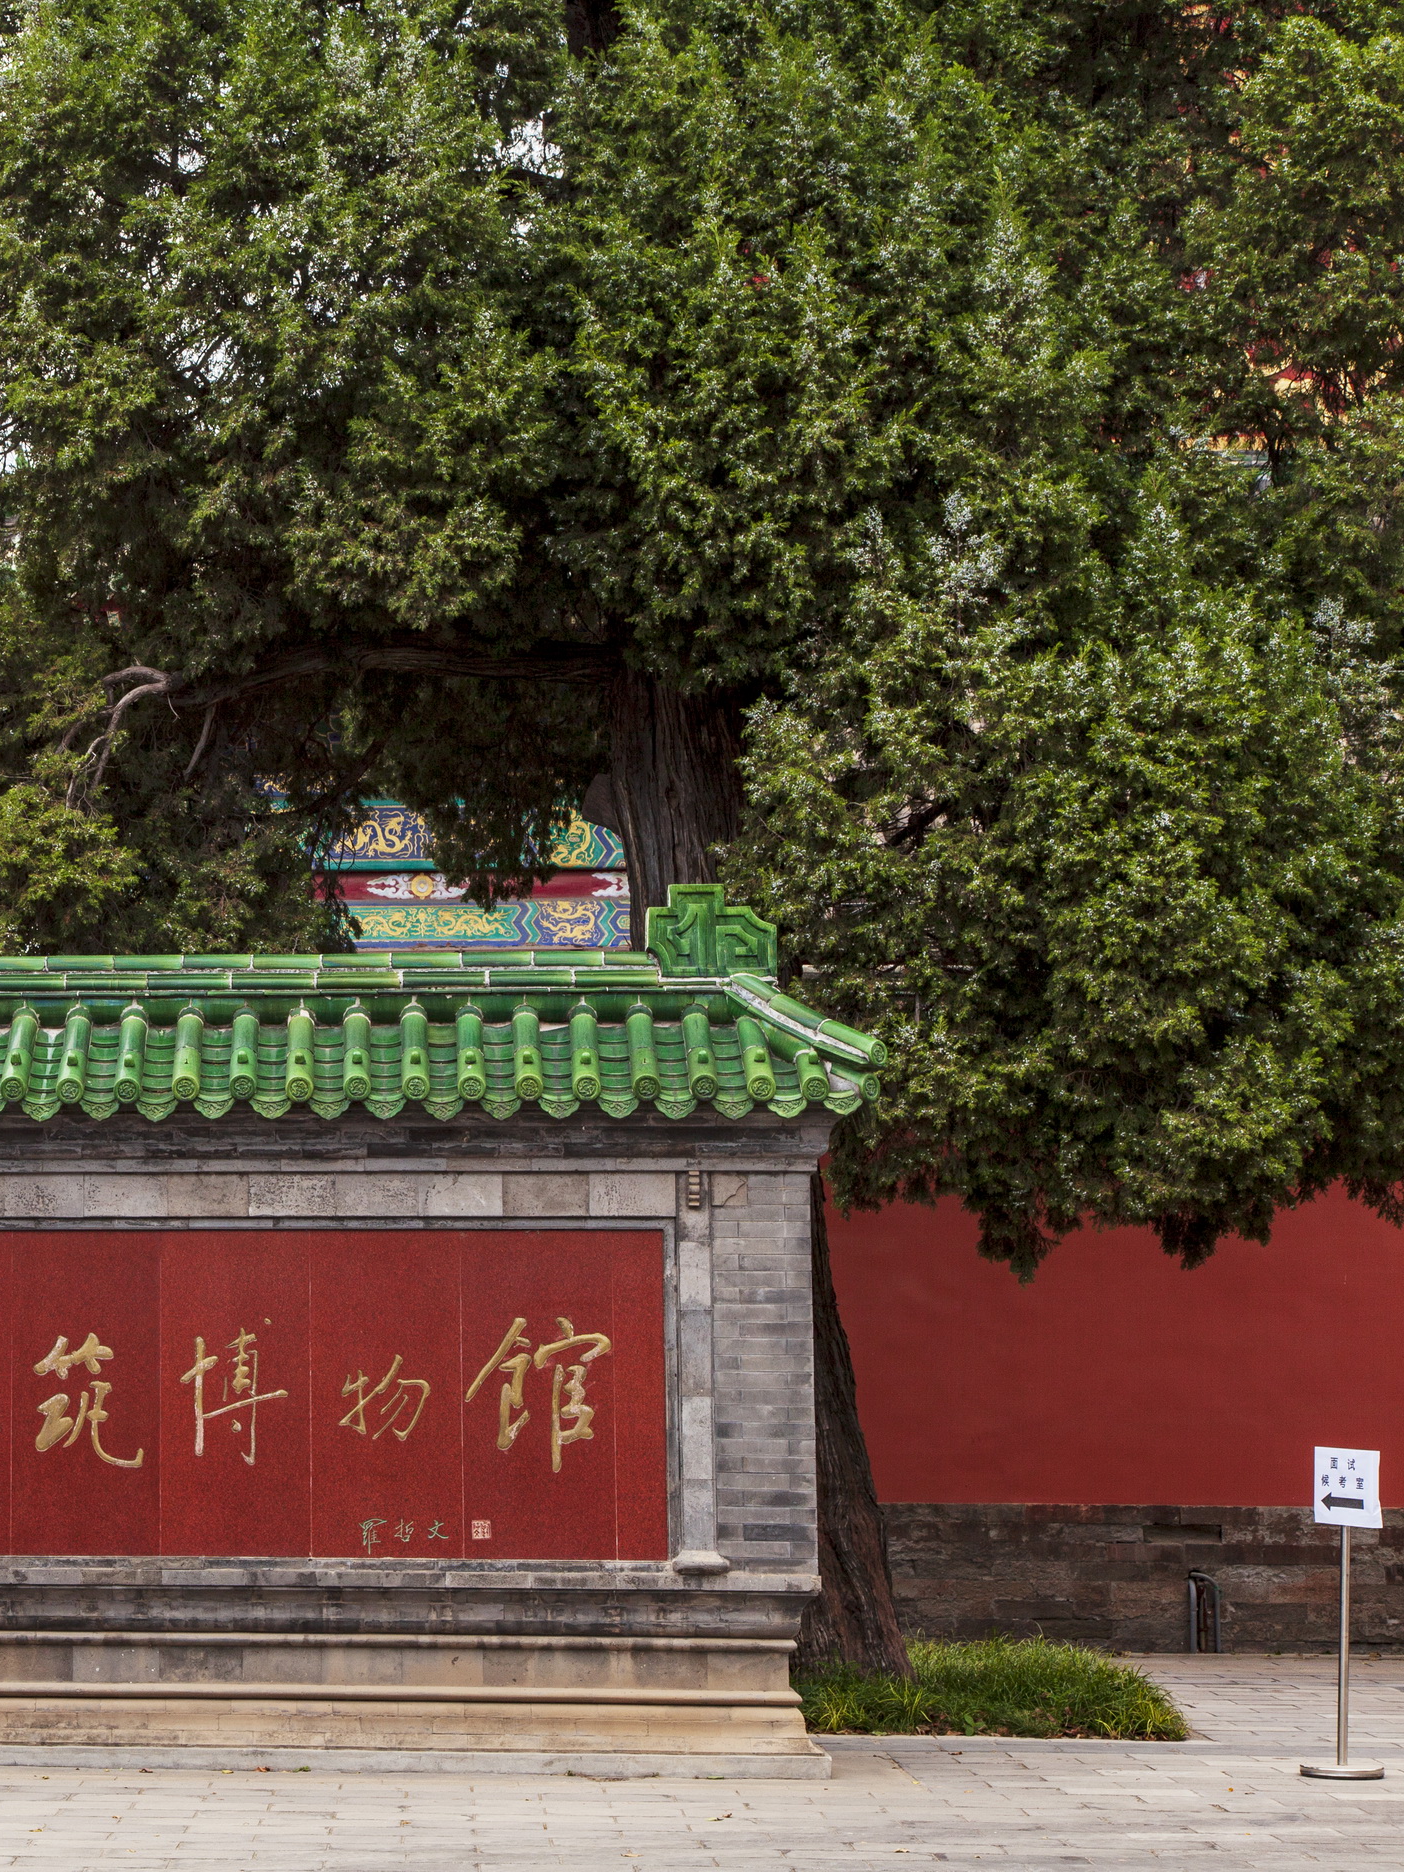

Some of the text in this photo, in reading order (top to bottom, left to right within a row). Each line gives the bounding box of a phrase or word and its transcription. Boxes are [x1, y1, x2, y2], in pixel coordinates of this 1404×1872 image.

[1330, 1456, 1356, 1471] 面试
[1321, 1474, 1364, 1490] 候考室
